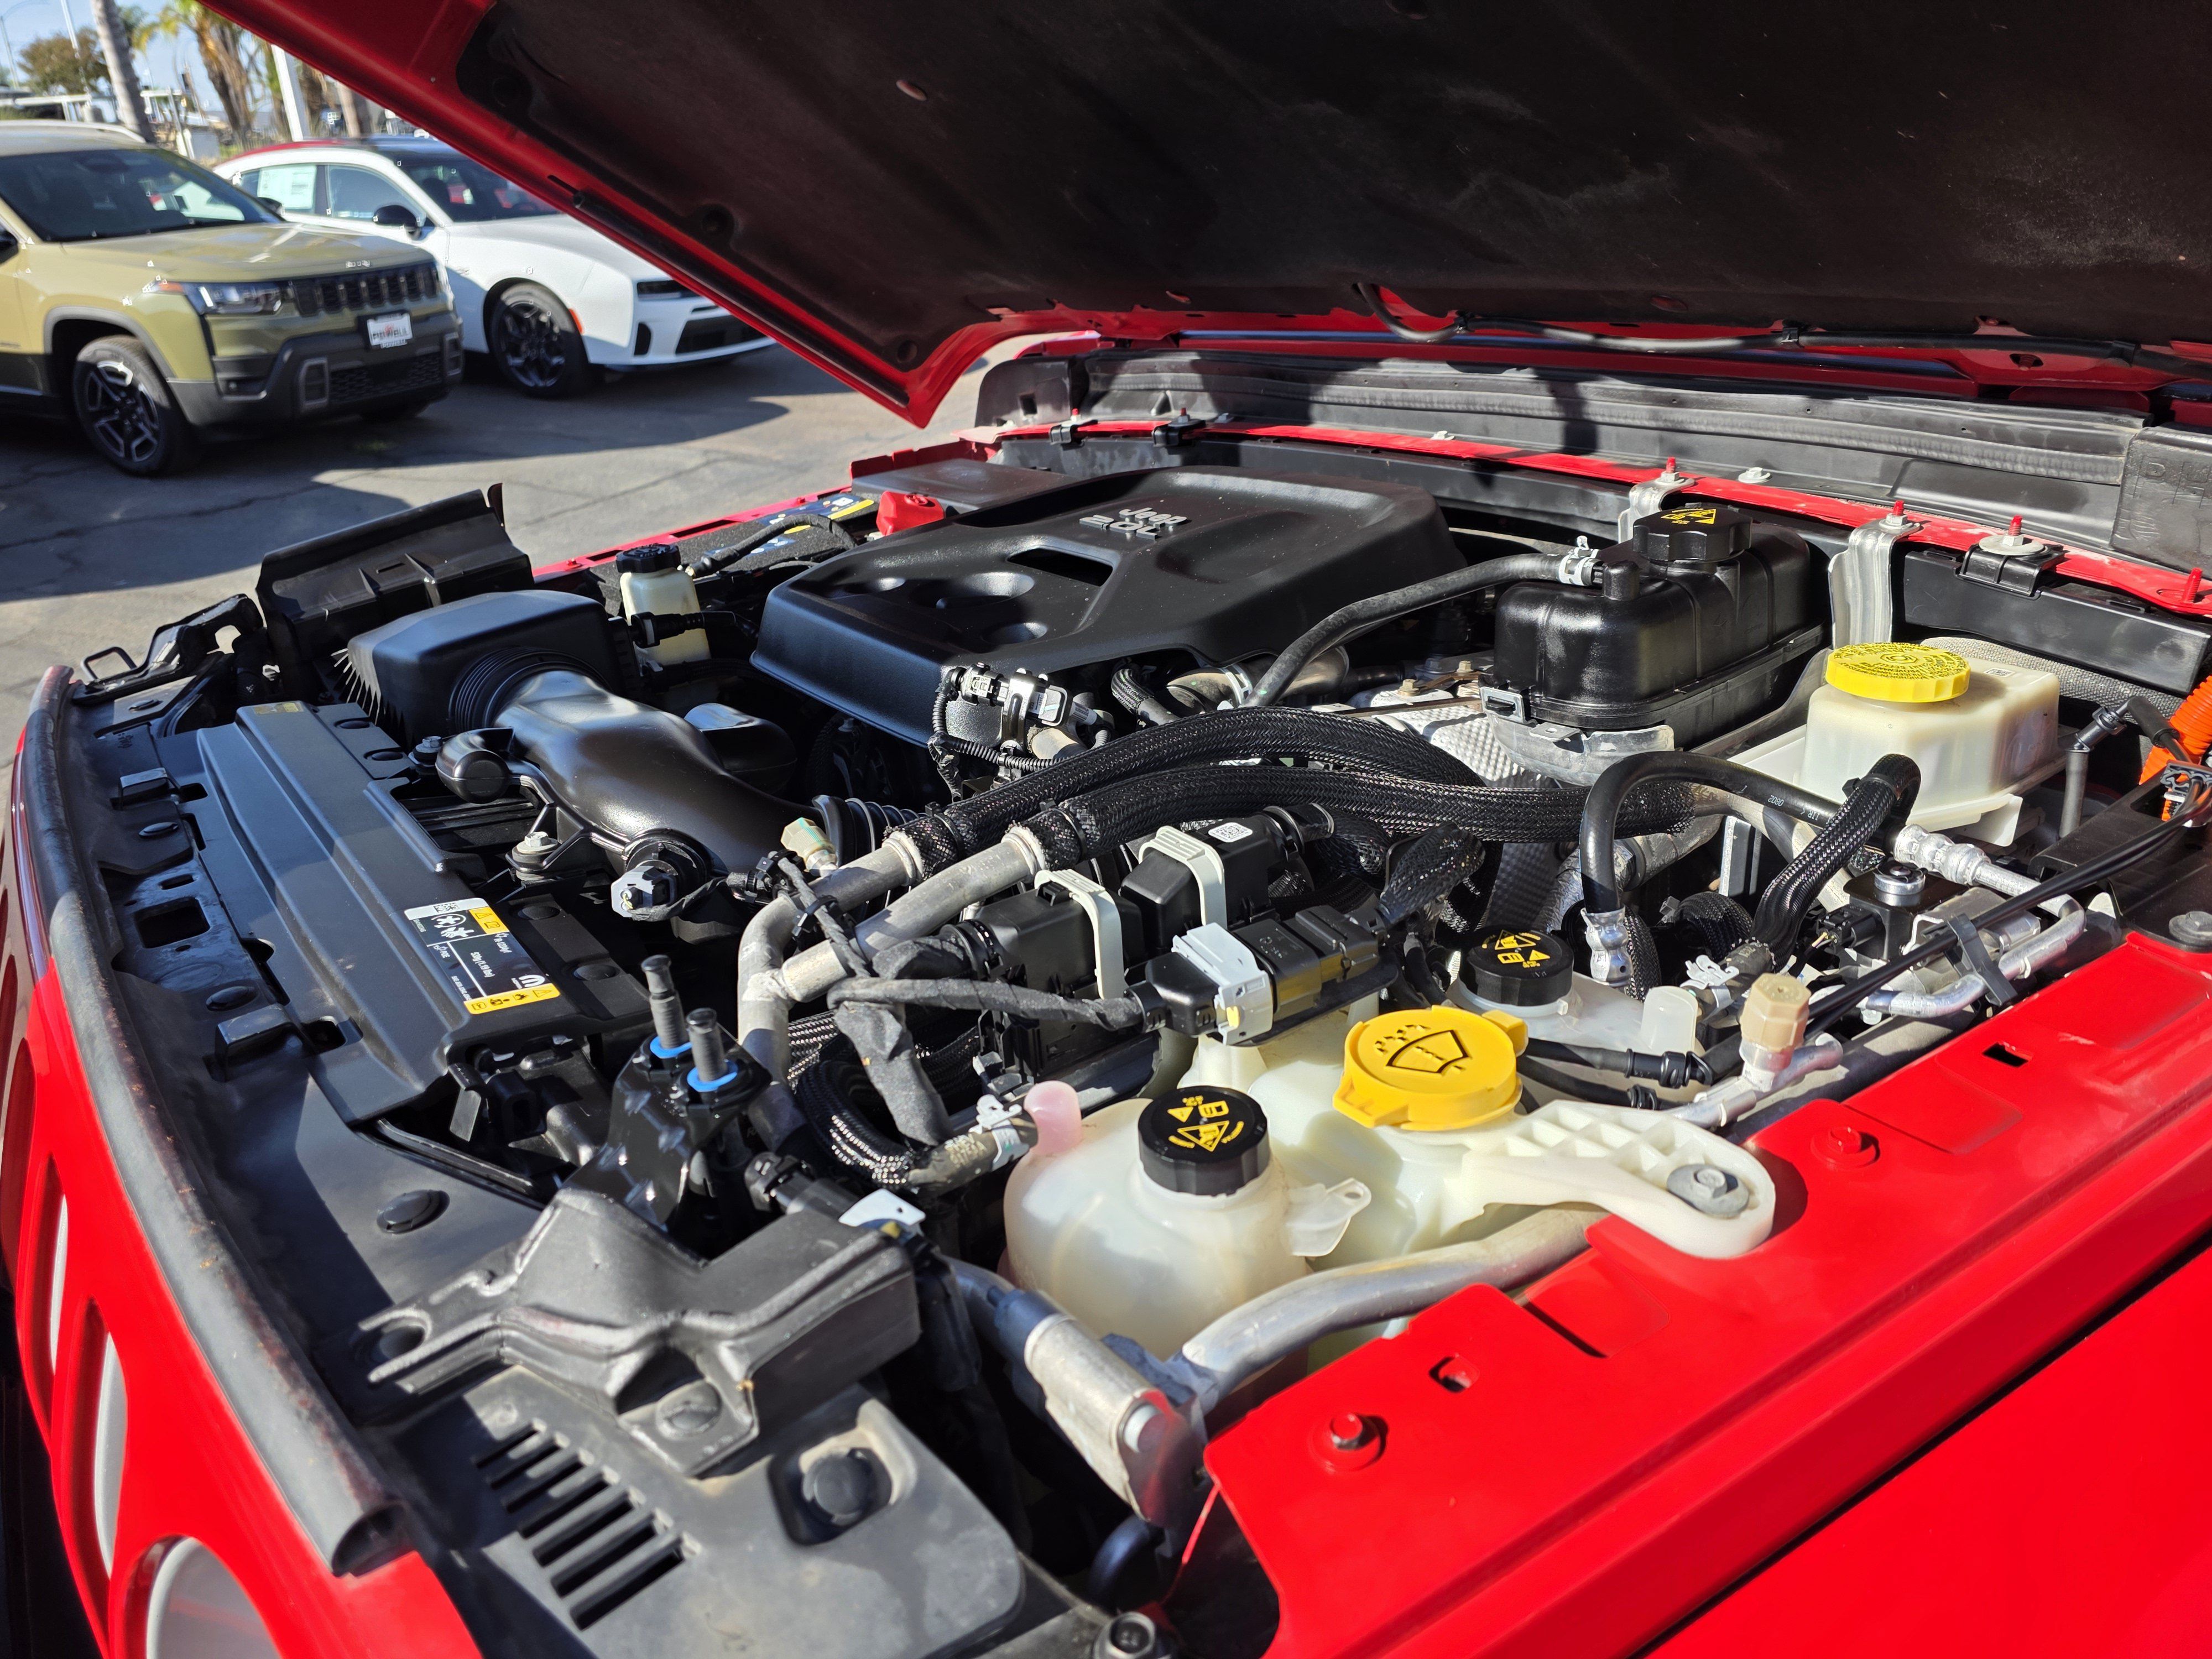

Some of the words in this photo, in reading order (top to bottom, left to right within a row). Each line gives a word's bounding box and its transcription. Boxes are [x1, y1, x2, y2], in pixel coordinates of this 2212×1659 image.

[1079, 514, 1160, 540] 2.0L
[1119, 507, 1187, 529] Jeep
[1767, 795, 1785, 807] 0802
